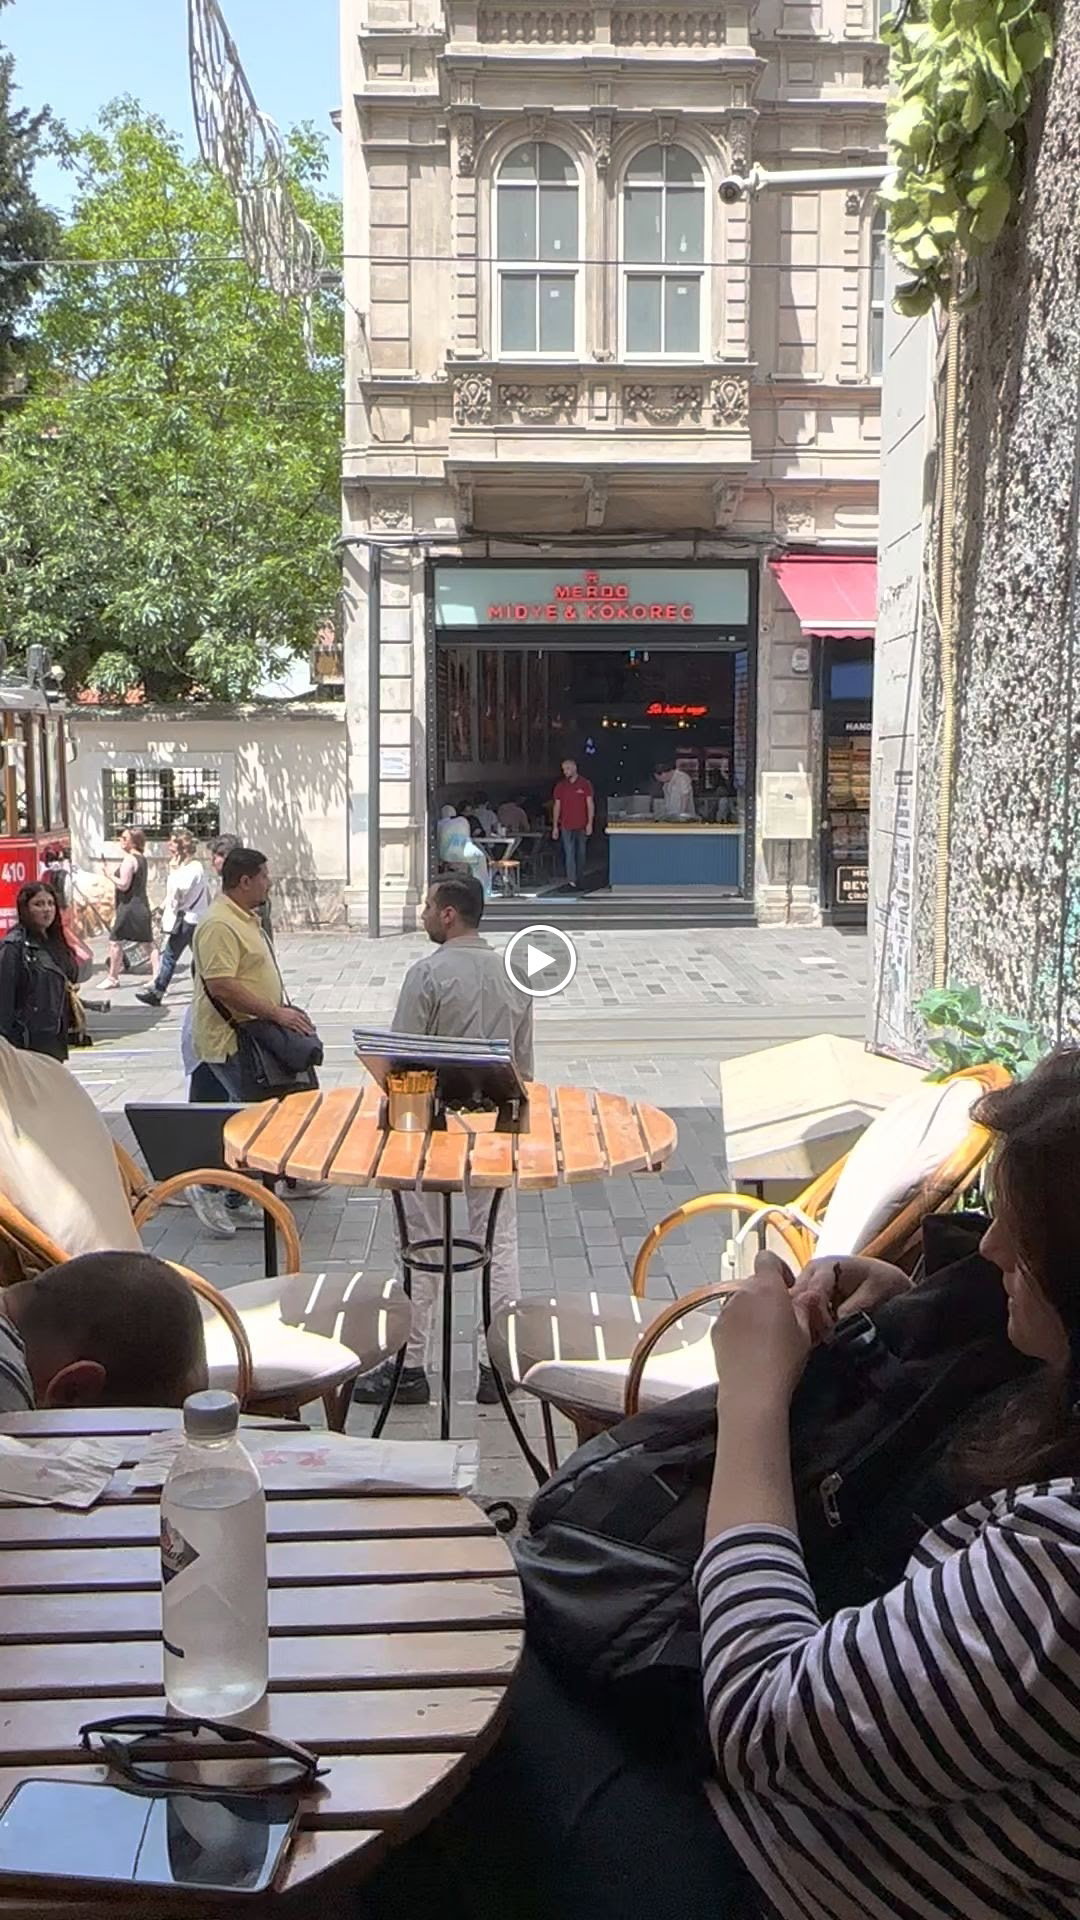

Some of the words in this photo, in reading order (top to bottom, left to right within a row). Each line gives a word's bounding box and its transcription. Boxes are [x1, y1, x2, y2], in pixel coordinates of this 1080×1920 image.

[555, 586, 628, 598] MERDO
[564, 604, 577, 619] &
[2, 862, 26, 882] 410
